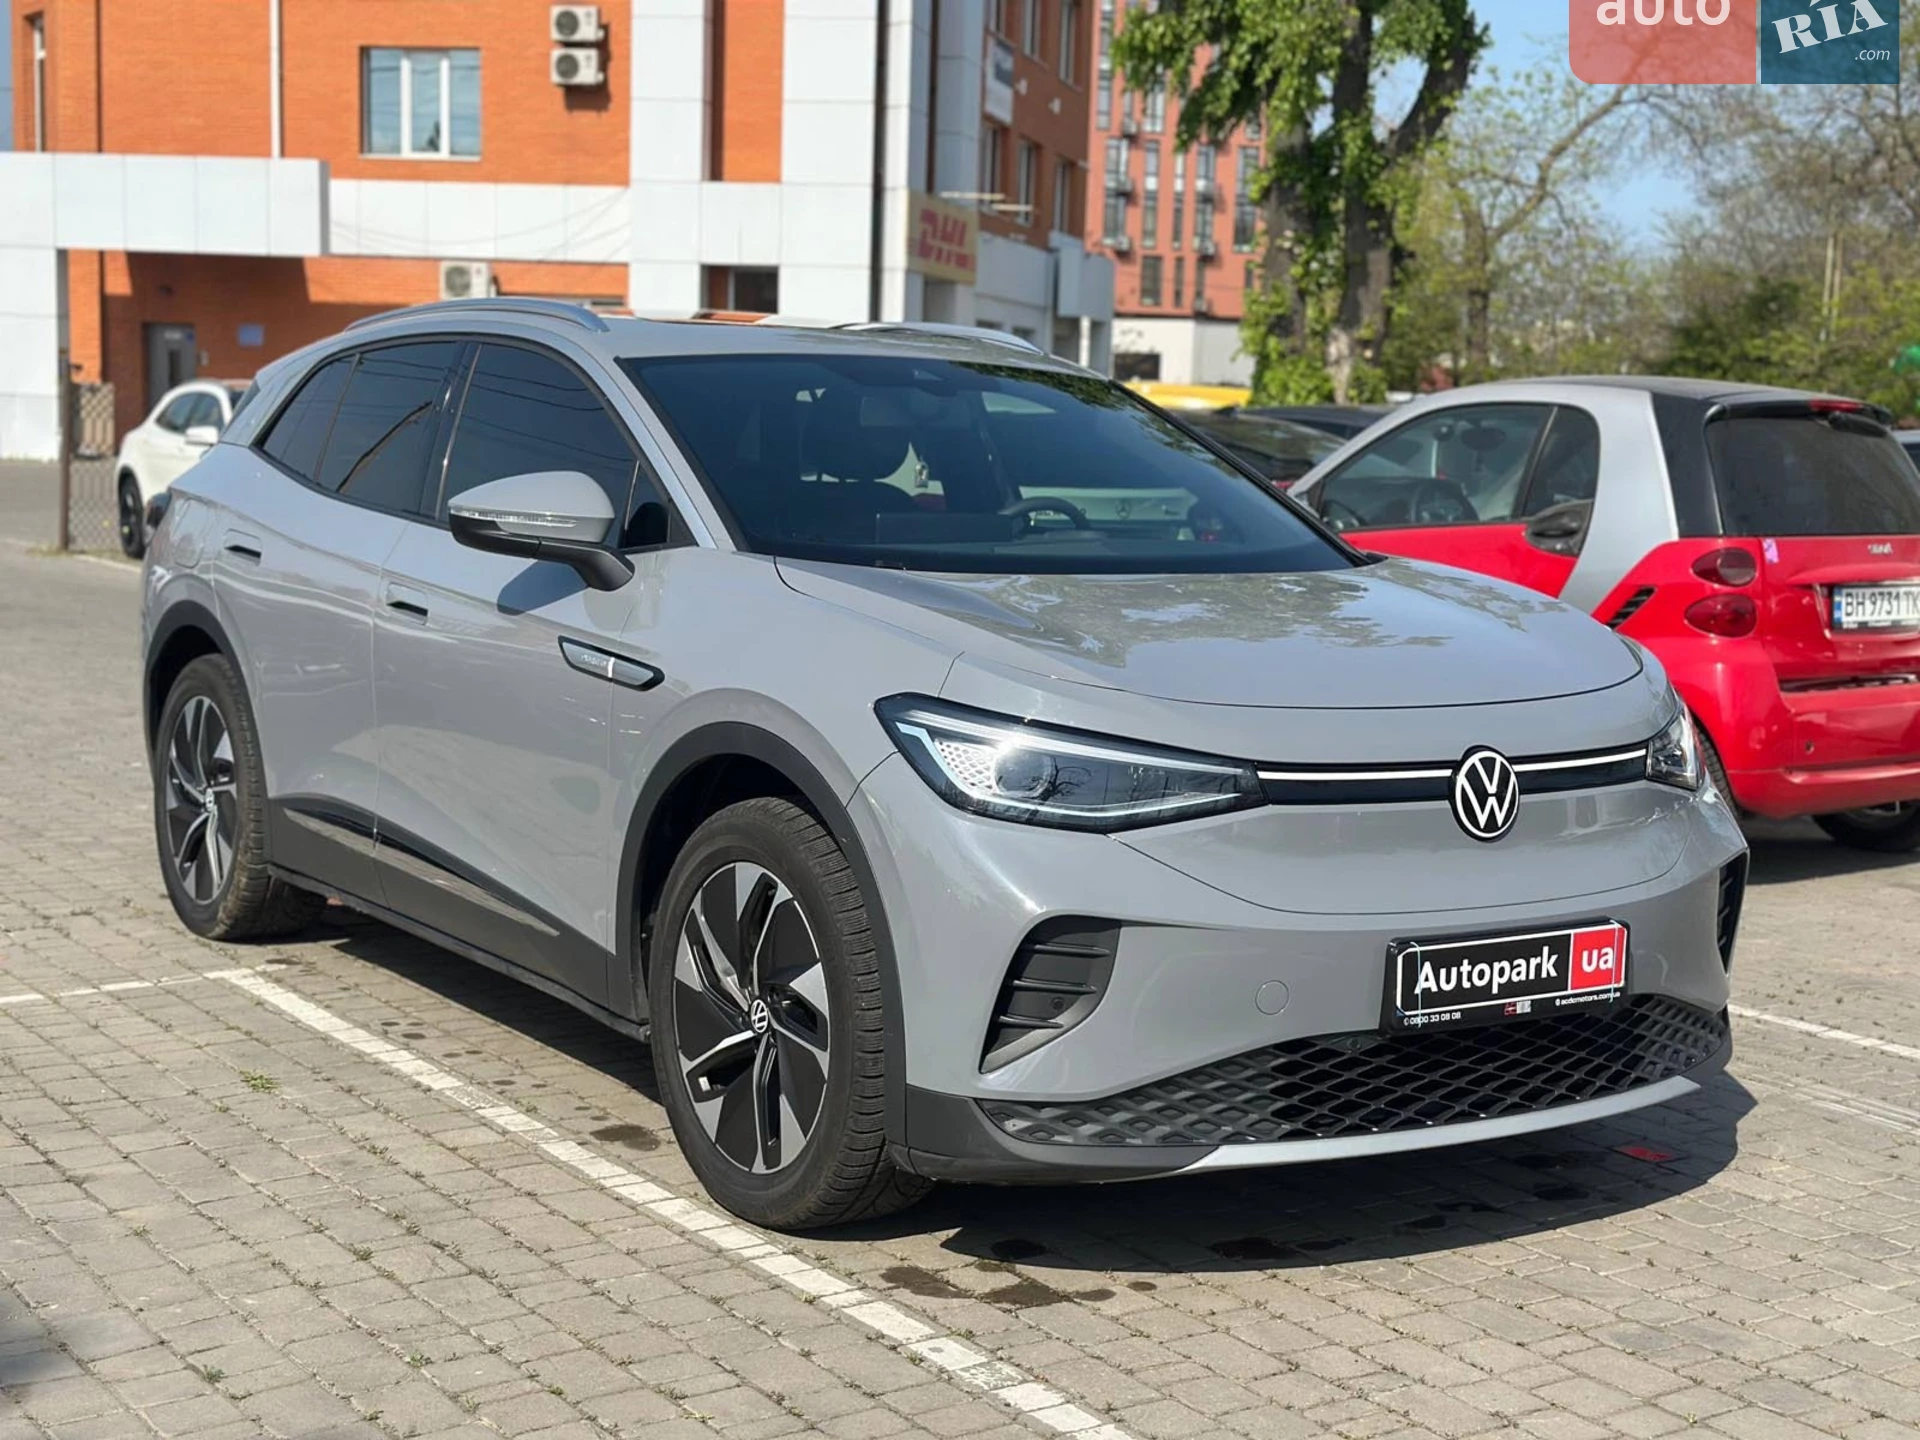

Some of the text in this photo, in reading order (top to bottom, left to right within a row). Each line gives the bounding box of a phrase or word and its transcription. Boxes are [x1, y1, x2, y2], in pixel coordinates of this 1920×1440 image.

[1845, 591, 1866, 617] BH
[1869, 591, 1901, 617] 9731
[1414, 945, 1614, 995] Autopark ua
[1561, 991, 1621, 1006] acdcmotors.comua
[1430, 1014, 1440, 1023] 33
